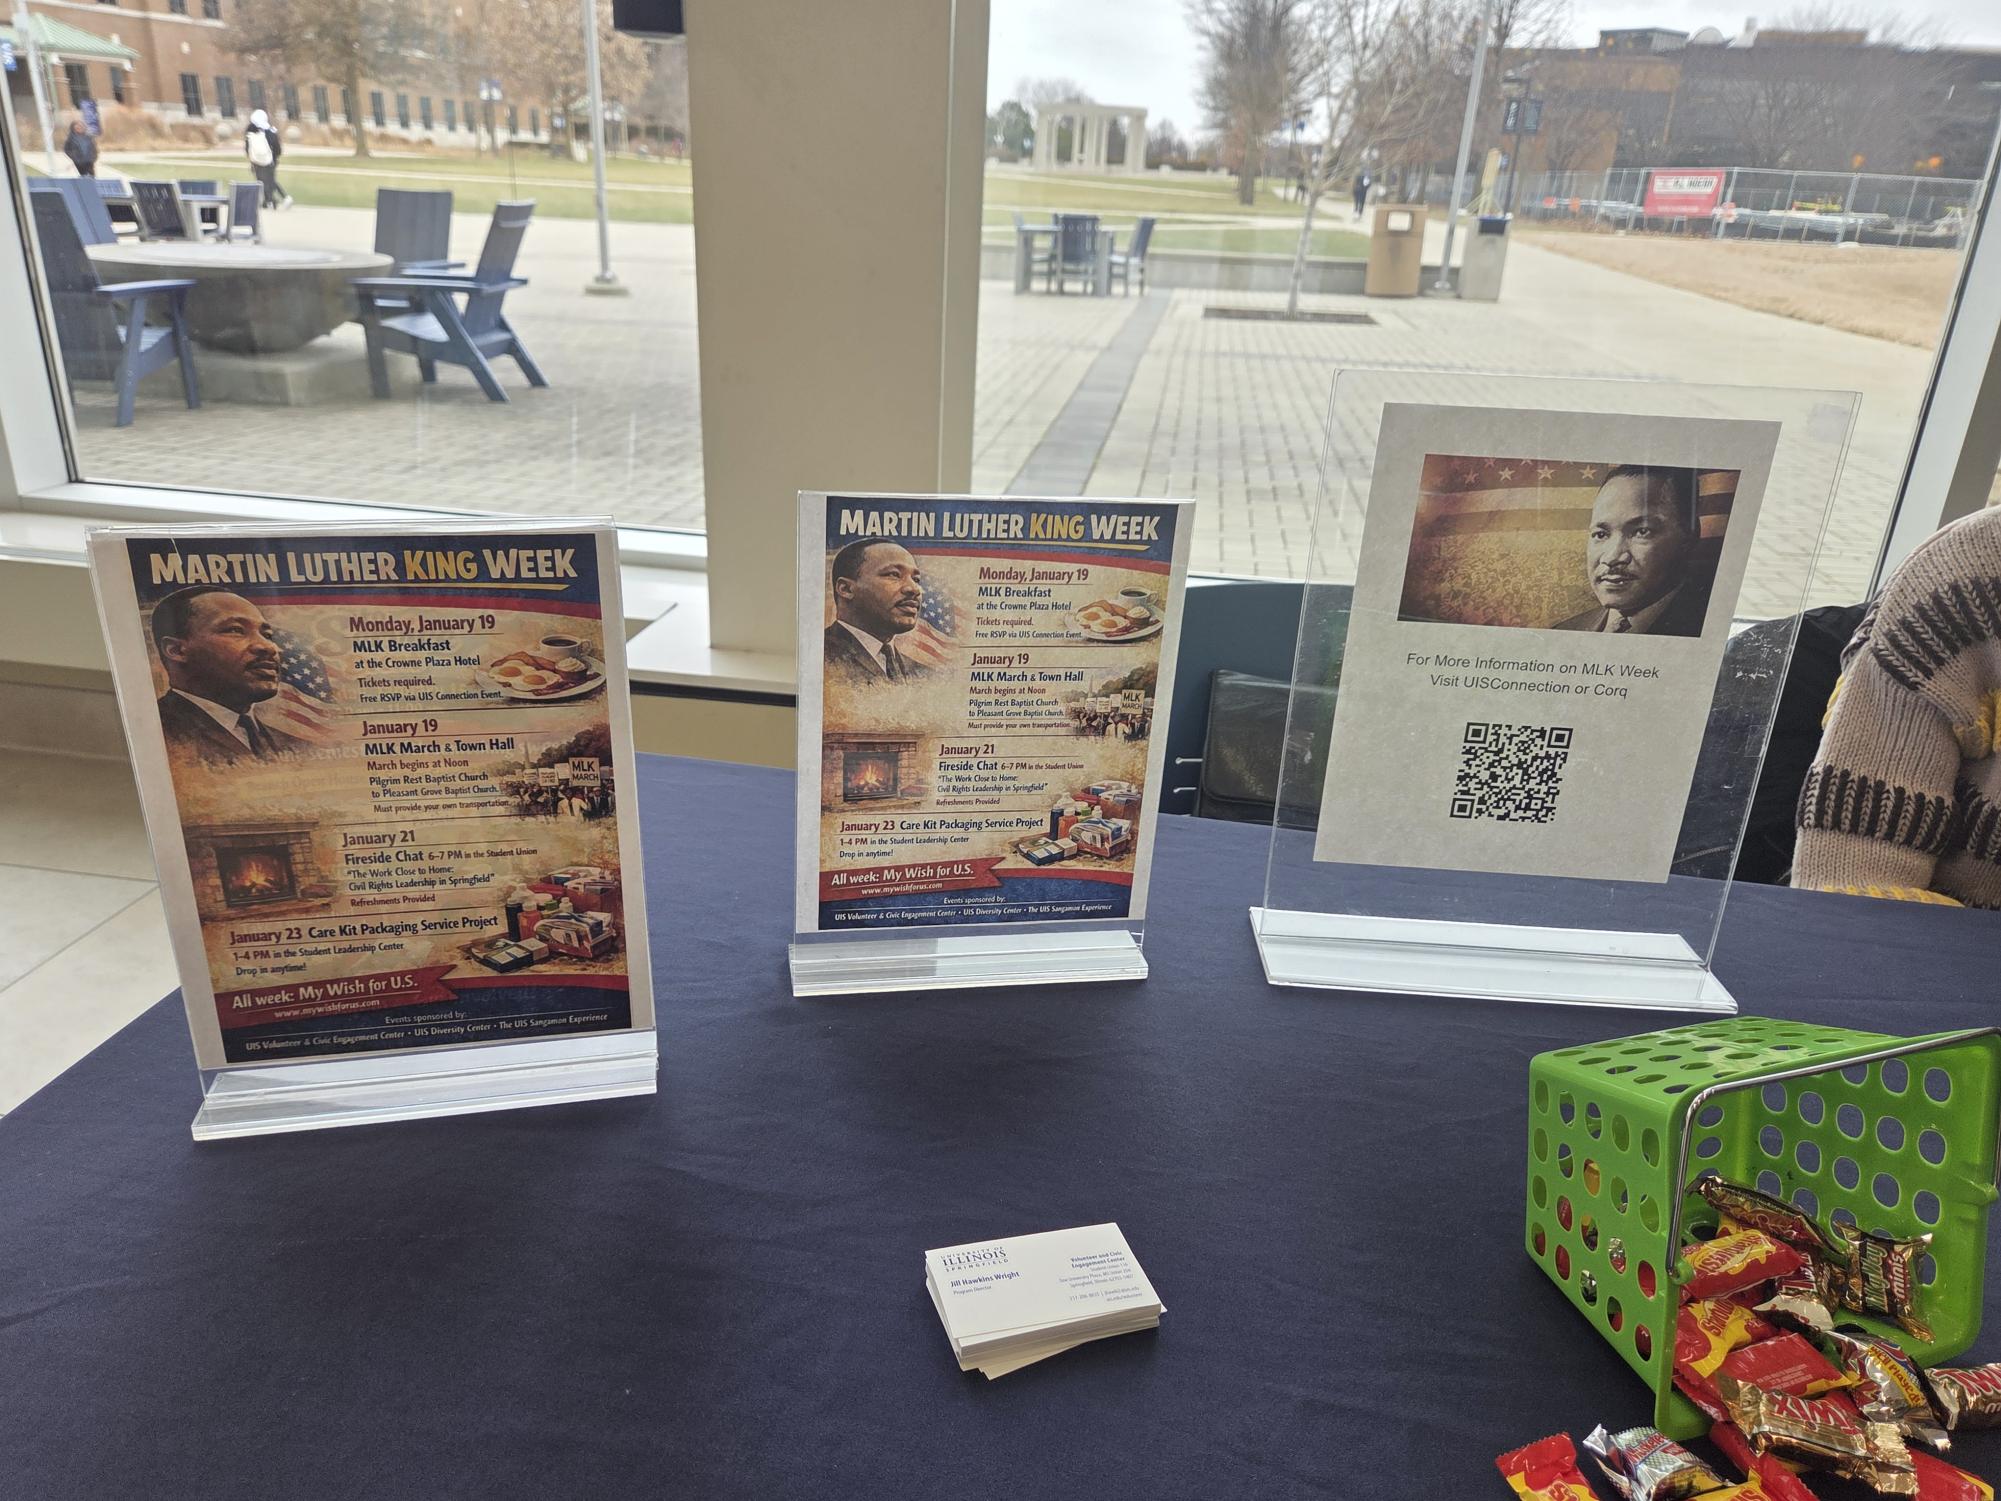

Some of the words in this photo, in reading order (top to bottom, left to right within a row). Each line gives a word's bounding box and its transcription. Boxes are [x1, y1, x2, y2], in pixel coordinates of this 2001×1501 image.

[840, 510, 935, 537] MARTIN
[942, 512, 1024, 538] LUTHER
[1030, 514, 1084, 540] KING
[1090, 514, 1160, 541] WEEK
[150, 552, 280, 584] MARTIN
[287, 552, 398, 582] LUTHER
[404, 550, 478, 580] KING
[483, 548, 578, 579] WEEK
[979, 566, 1027, 583] Monday,
[1029, 567, 1073, 584] January
[1076, 567, 1088, 581] 19
[978, 585, 1001, 597] MLK
[1004, 586, 1051, 597] Breakfast
[976, 600, 983, 610] at
[986, 600, 997, 610] the
[999, 600, 1027, 610] Crowne
[1029, 601, 1048, 610] Plaza
[1051, 601, 1071, 611] Hotel
[349, 616, 414, 635] Monday,
[418, 615, 474, 634] January
[478, 614, 495, 629] 19
[976, 616, 1000, 626] Tickets
[1002, 616, 1033, 628] required.
[353, 640, 384, 653] MLK
[388, 638, 450, 652] Breakfast
[354, 657, 364, 669] at
[366, 657, 382, 669] the
[385, 656, 421, 668] Crowne
[424, 655, 451, 667] Plaza
[453, 654, 480, 666] Hotel
[971, 652, 1014, 668] January
[1017, 652, 1028, 665] 19
[1406, 653, 1430, 666] For
[1434, 654, 1470, 668] More
[1475, 657, 1554, 673] Information
[1559, 664, 1576, 674] on
[1581, 662, 1614, 676] MLK
[1620, 664, 1659, 679] Week
[356, 676, 390, 688] Tickets
[393, 675, 435, 689] required.
[970, 670, 993, 682] MLK
[996, 670, 1027, 681] March
[1030, 670, 1035, 681] &
[1038, 670, 1061, 681] Town
[1064, 670, 1083, 681] Hall
[969, 685, 991, 695] March
[994, 685, 1015, 696] begins
[1018, 685, 1024, 694] at
[1027, 685, 1045, 694] Noon
[1430, 673, 1458, 687] Visit
[1463, 675, 1570, 693] UISConnection
[1574, 684, 1589, 694] or
[1593, 682, 1627, 700] Corq
[359, 693, 377, 703] Free
[379, 692, 401, 702] RSVP
[403, 691, 415, 701] via
[418, 691, 433, 701] UIS
[435, 689, 478, 700] Connection
[480, 688, 503, 698] Event.
[969, 697, 992, 708] Pilgrim
[994, 697, 1008, 706] Rest
[1010, 697, 1033, 708] Baptist
[1035, 697, 1058, 706] Church
[1124, 692, 1140, 702] MLK
[1122, 702, 1141, 710] MARCH
[361, 720, 418, 738] January
[422, 719, 437, 733] 19
[365, 742, 396, 756] MLK
[399, 740, 440, 754] March
[444, 740, 452, 752] &
[454, 738, 485, 752] Town
[489, 737, 514, 751] Hall
[938, 742, 980, 758] January
[982, 742, 994, 754] 21
[367, 760, 396, 771] March
[399, 758, 429, 772] begins
[431, 758, 441, 768] at
[443, 757, 468, 768] Noon
[572, 761, 594, 772] MLK
[939, 760, 973, 771] Fireside
[976, 760, 997, 771] Chat
[1015, 761, 1026, 770] PM
[1028, 761, 1033, 770] in
[1035, 761, 1043, 769] the
[1044, 761, 1065, 769] Student
[1067, 760, 1083, 769] Union
[572, 772, 599, 782] MARCH
[840, 819, 880, 835] January
[882, 819, 894, 830] 23
[900, 818, 920, 830] Care
[923, 818, 936, 829] Kit
[939, 818, 982, 832] Packaging
[985, 816, 1014, 828] Service
[1015, 816, 1043, 830] Project
[341, 830, 396, 850] January
[399, 829, 414, 843] 21
[344, 850, 391, 865] Fireside
[395, 848, 423, 862] Chat
[447, 848, 462, 858] PM
[464, 848, 470, 857] in
[472, 847, 484, 856] the
[486, 845, 513, 856] Student
[515, 844, 537, 854] Union
[839, 849, 855, 860] Drop
[857, 848, 863, 857] in
[865, 848, 893, 859] anytime!
[830, 872, 847, 885] All
[849, 869, 879, 884] week:
[882, 867, 902, 884] My
[905, 865, 933, 879] Wish
[936, 864, 951, 877] for
[953, 862, 973, 875] U.S.
[861, 882, 942, 896] www.mywishforus.com
[229, 929, 282, 946] January
[284, 927, 302, 940] 23
[308, 925, 335, 939] Care
[339, 924, 357, 937] Kit
[360, 920, 418, 939] Packaging
[420, 917, 459, 931] Service
[461, 914, 498, 931] Project
[235, 965, 257, 978] Drop
[258, 964, 268, 974] in
[270, 961, 306, 976] anytime!
[231, 993, 251, 1009] All
[254, 989, 294, 1006] week:
[298, 985, 324, 1005] My
[326, 981, 364, 998] Wish
[368, 978, 387, 993] for
[390, 975, 417, 991] U.S.
[274, 999, 380, 1021] www.mywishforus.com
[943, 1250, 1006, 1266] ILLINOIS
[946, 1259, 1008, 1272] SPRINGFIELD
[962, 1276, 994, 1286] Hawkins
[994, 1271, 1020, 1280] Wright
